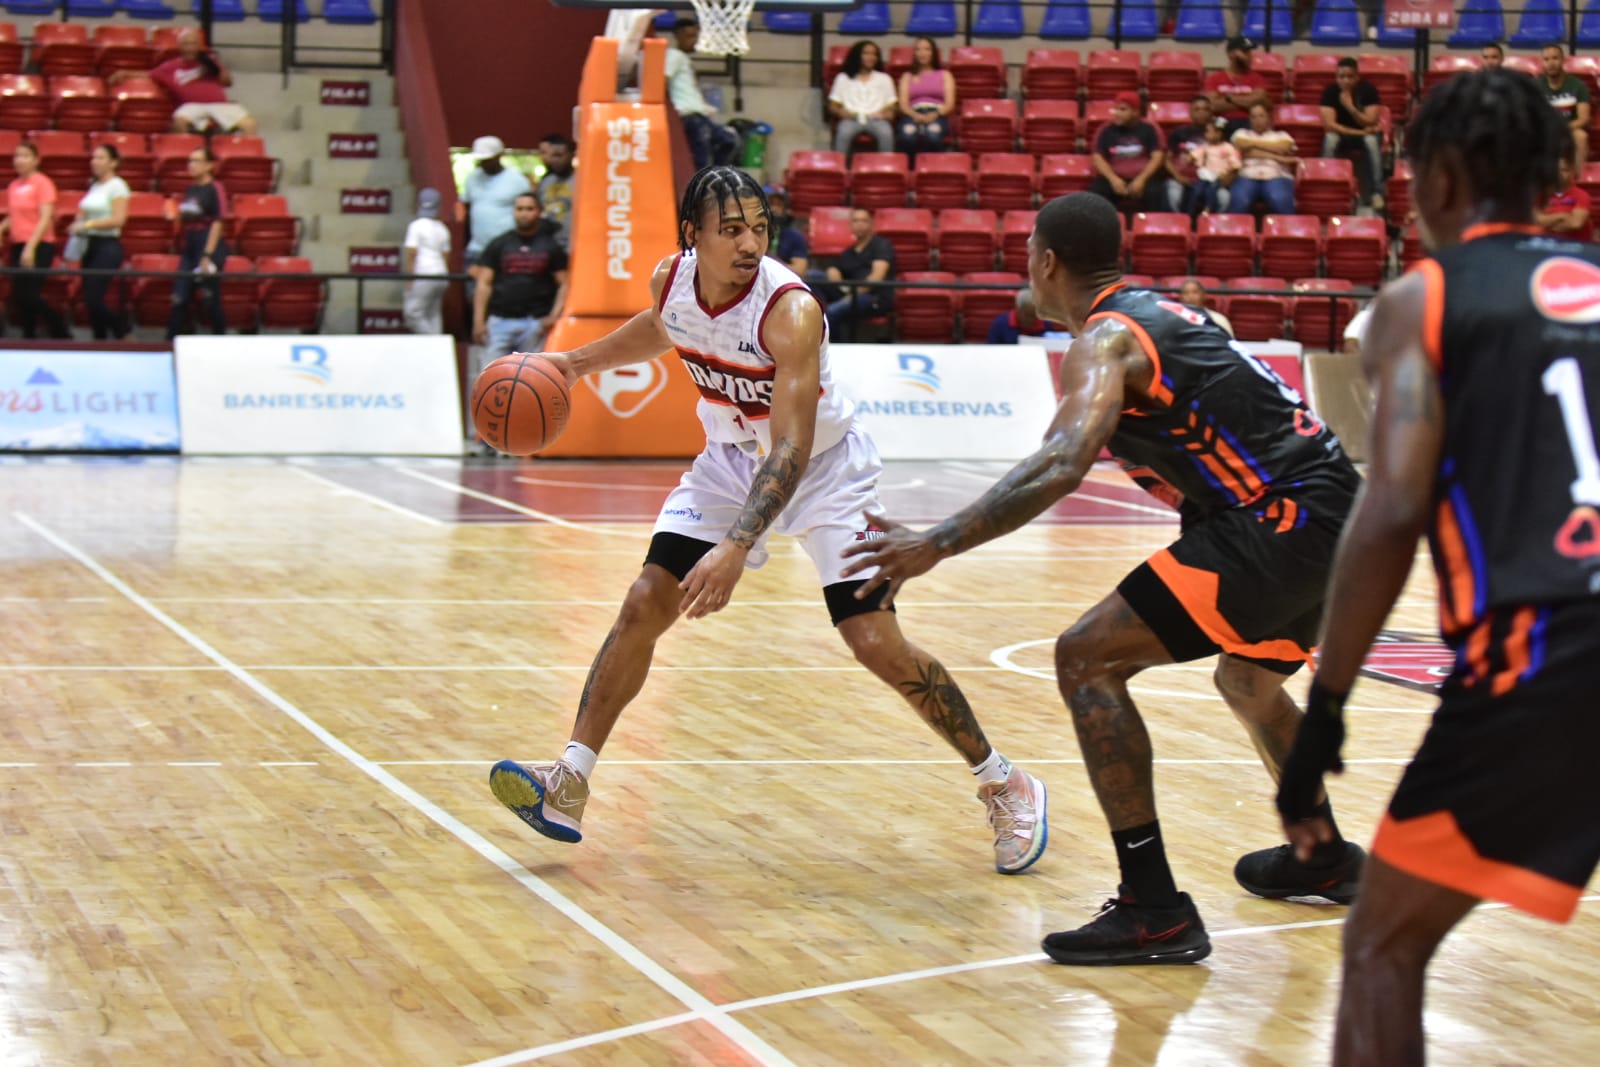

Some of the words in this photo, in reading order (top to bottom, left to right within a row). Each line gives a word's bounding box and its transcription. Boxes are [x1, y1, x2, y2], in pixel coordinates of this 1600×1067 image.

[52, 392, 160, 414] LIGHT
[224, 394, 406, 409] BANRESERVAS
[856, 400, 1013, 417] ANRESERVAS
